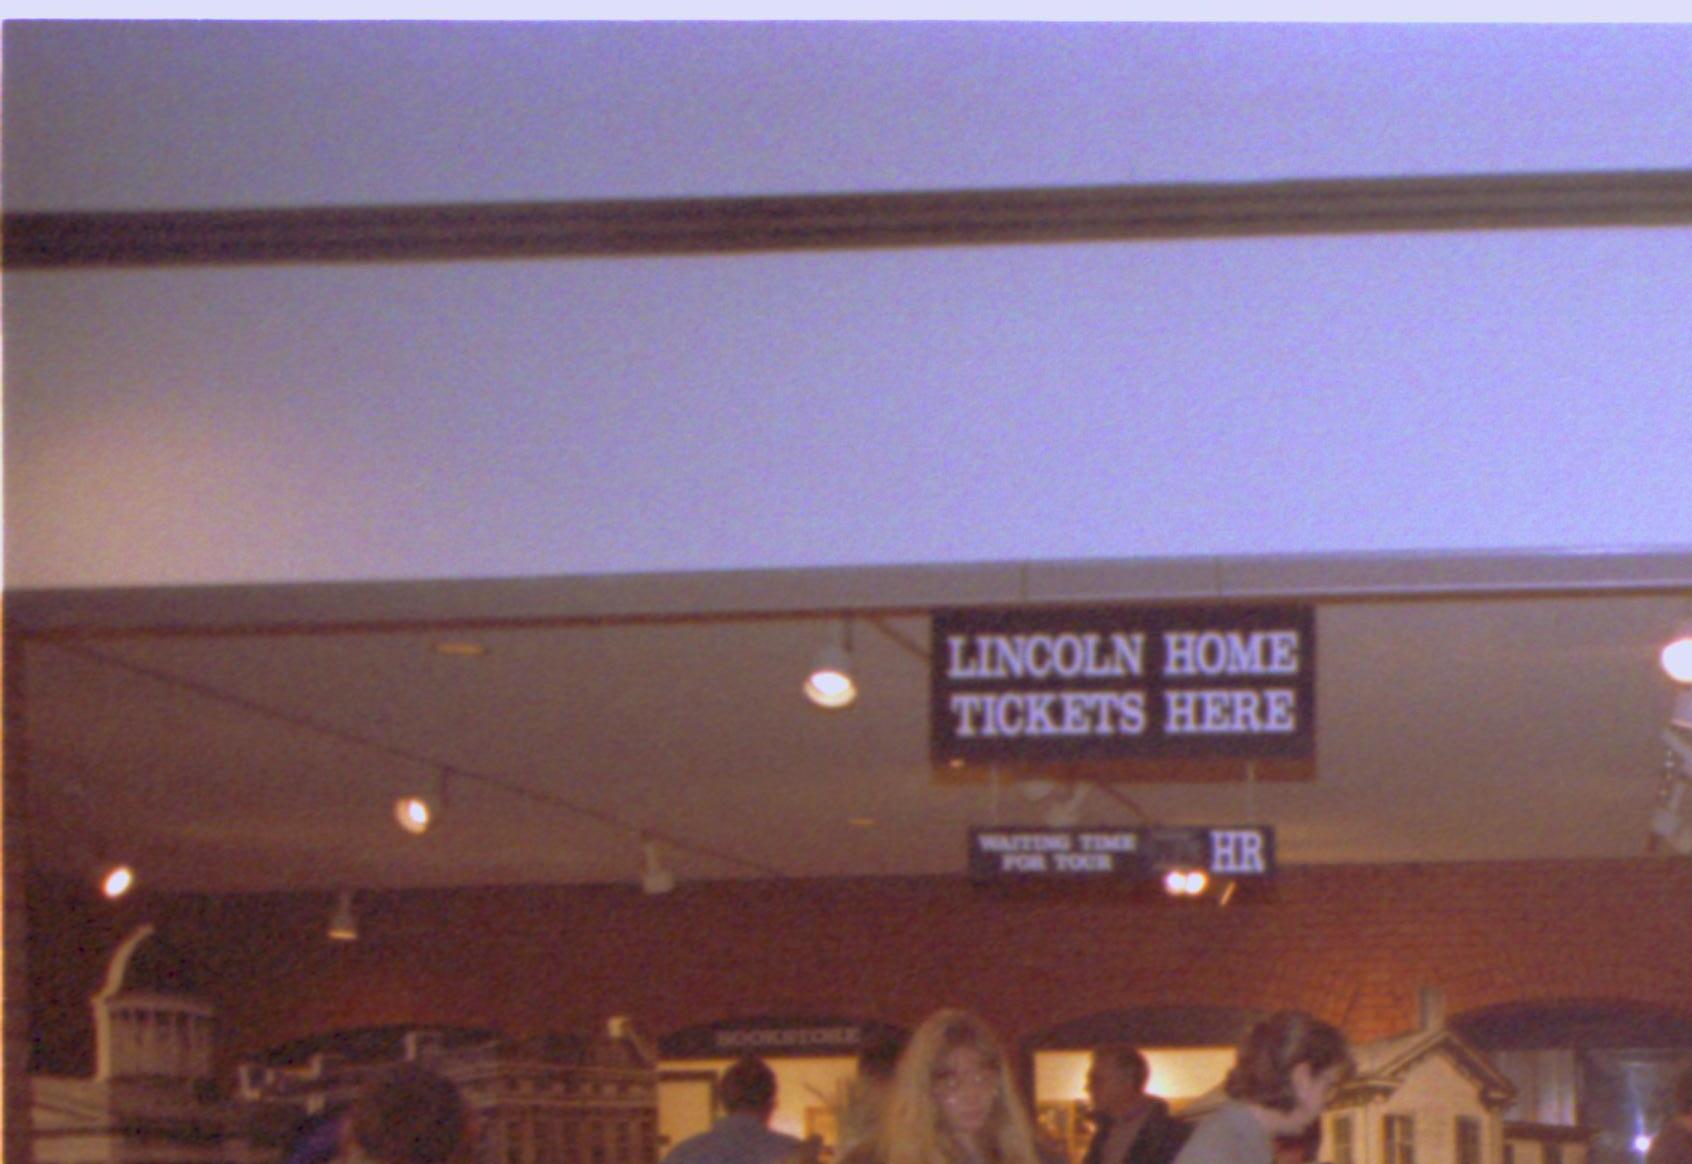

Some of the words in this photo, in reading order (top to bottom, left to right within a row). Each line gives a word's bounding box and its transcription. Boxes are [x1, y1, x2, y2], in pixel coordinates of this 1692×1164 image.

[947, 632, 1145, 679] LINCOLN
[1163, 630, 1299, 676] HOME
[950, 690, 1147, 737] TICKETS
[1163, 688, 1297, 733] HERE
[978, 834, 1071, 852] WAITING
[1079, 833, 1138, 851] TIME
[1001, 854, 1045, 872] FOR
[1054, 853, 1112, 871] TOUR
[1209, 830, 1265, 874] HR
